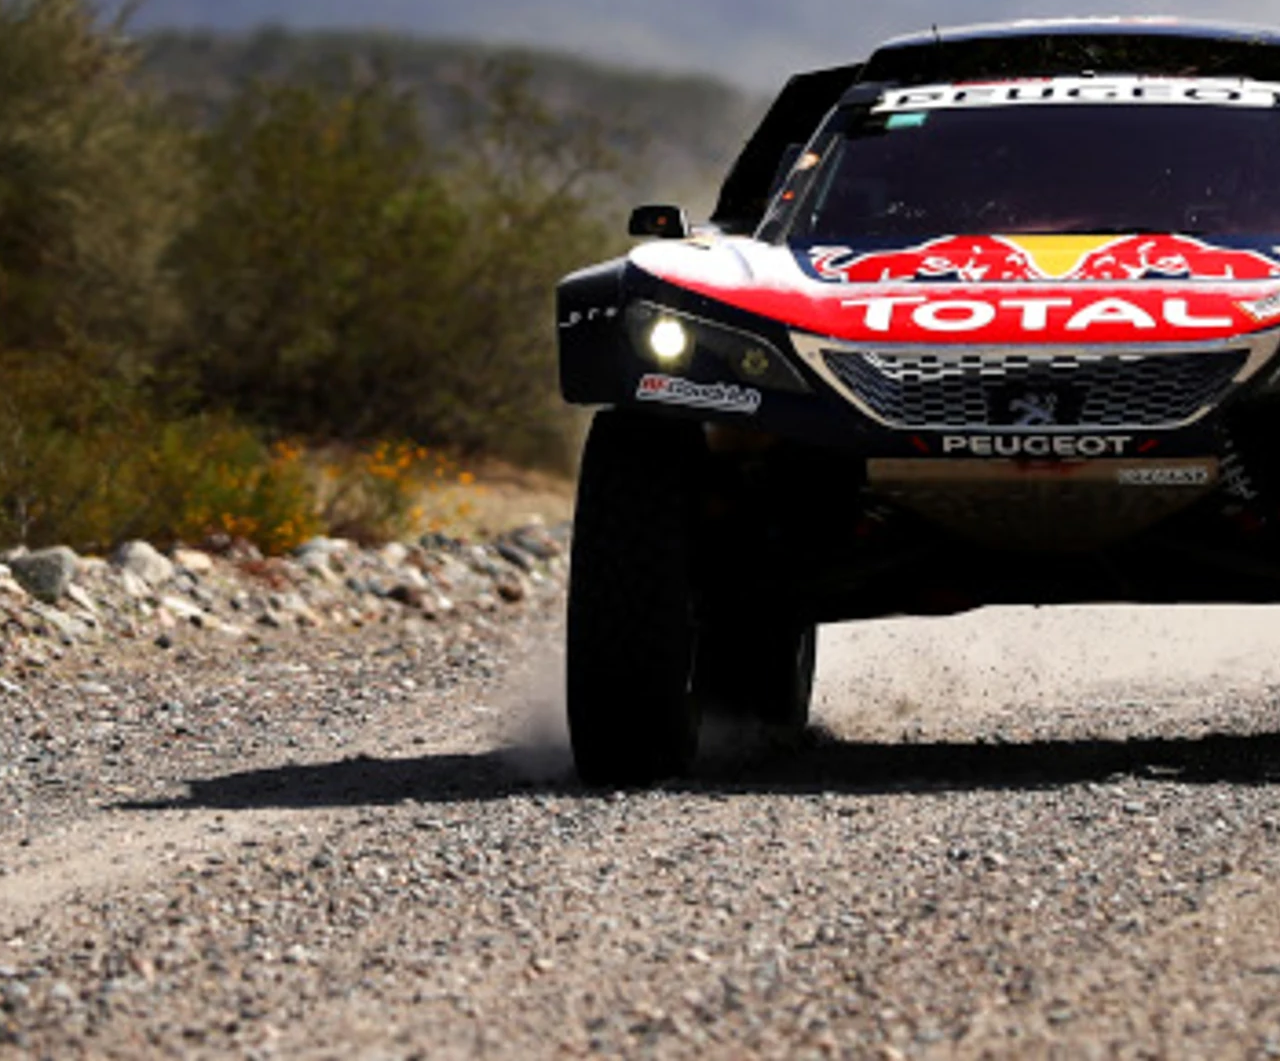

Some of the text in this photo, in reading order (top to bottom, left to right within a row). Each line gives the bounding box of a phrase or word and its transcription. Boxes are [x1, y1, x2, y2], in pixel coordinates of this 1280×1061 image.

[893, 84, 1274, 108] PEUGEO
[841, 295, 1233, 332] TOTAL
[942, 435, 1131, 455] PEUGEOT
